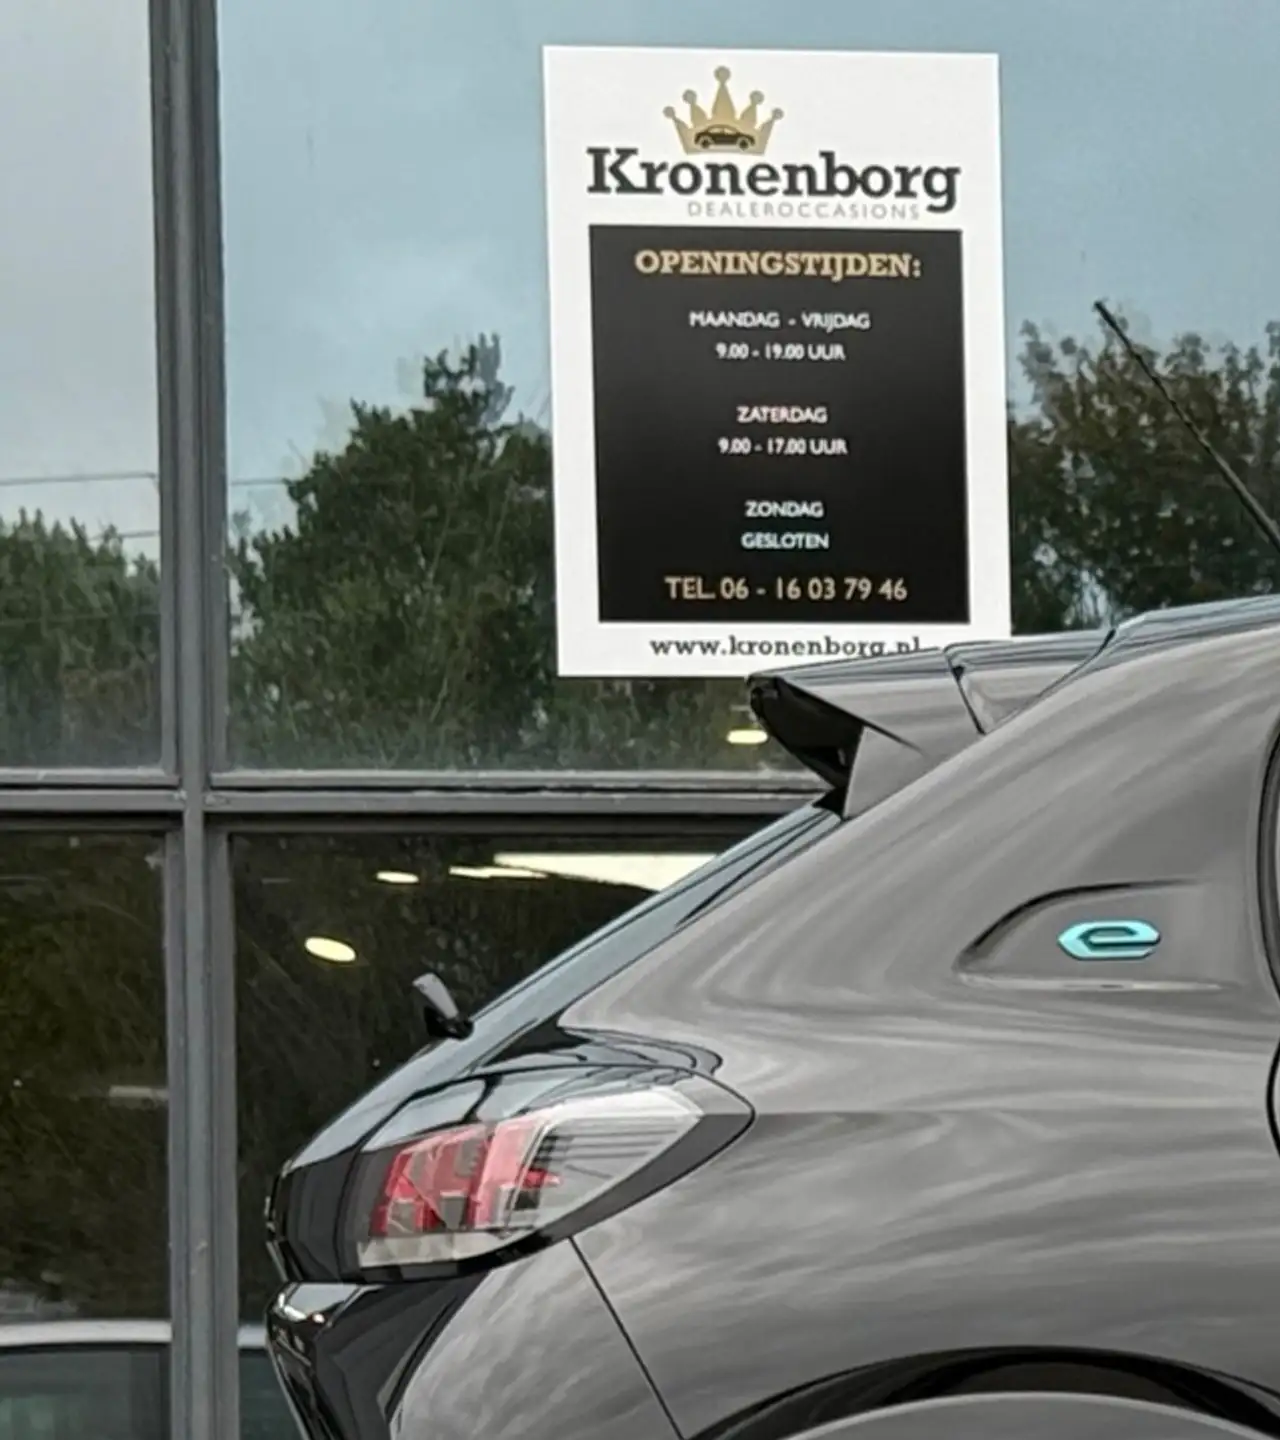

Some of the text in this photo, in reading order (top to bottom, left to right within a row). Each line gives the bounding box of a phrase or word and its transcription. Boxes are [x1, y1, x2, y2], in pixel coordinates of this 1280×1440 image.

[586, 146, 962, 213] Kronenborg
[686, 200, 920, 221] DEALEROCCASIONS
[634, 249, 921, 282] OPENINGSTIJDEN:
[689, 310, 780, 328] MAANDAG
[801, 311, 871, 333] VRIJDAG
[715, 341, 750, 360] 9.00
[765, 342, 805, 361] 19.00
[807, 343, 846, 361] UUR
[736, 405, 828, 424] ZATERDAG
[717, 436, 752, 455] 9.00
[767, 436, 807, 456] 17.00
[809, 437, 849, 456] UUR
[744, 500, 825, 518] ZONDAG
[740, 531, 830, 550] GESLOTEN
[719, 575, 750, 600] 06
[776, 576, 801, 600] 16
[807, 576, 836, 601] 03
[843, 577, 873, 601] 79
[878, 577, 908, 601] 46
